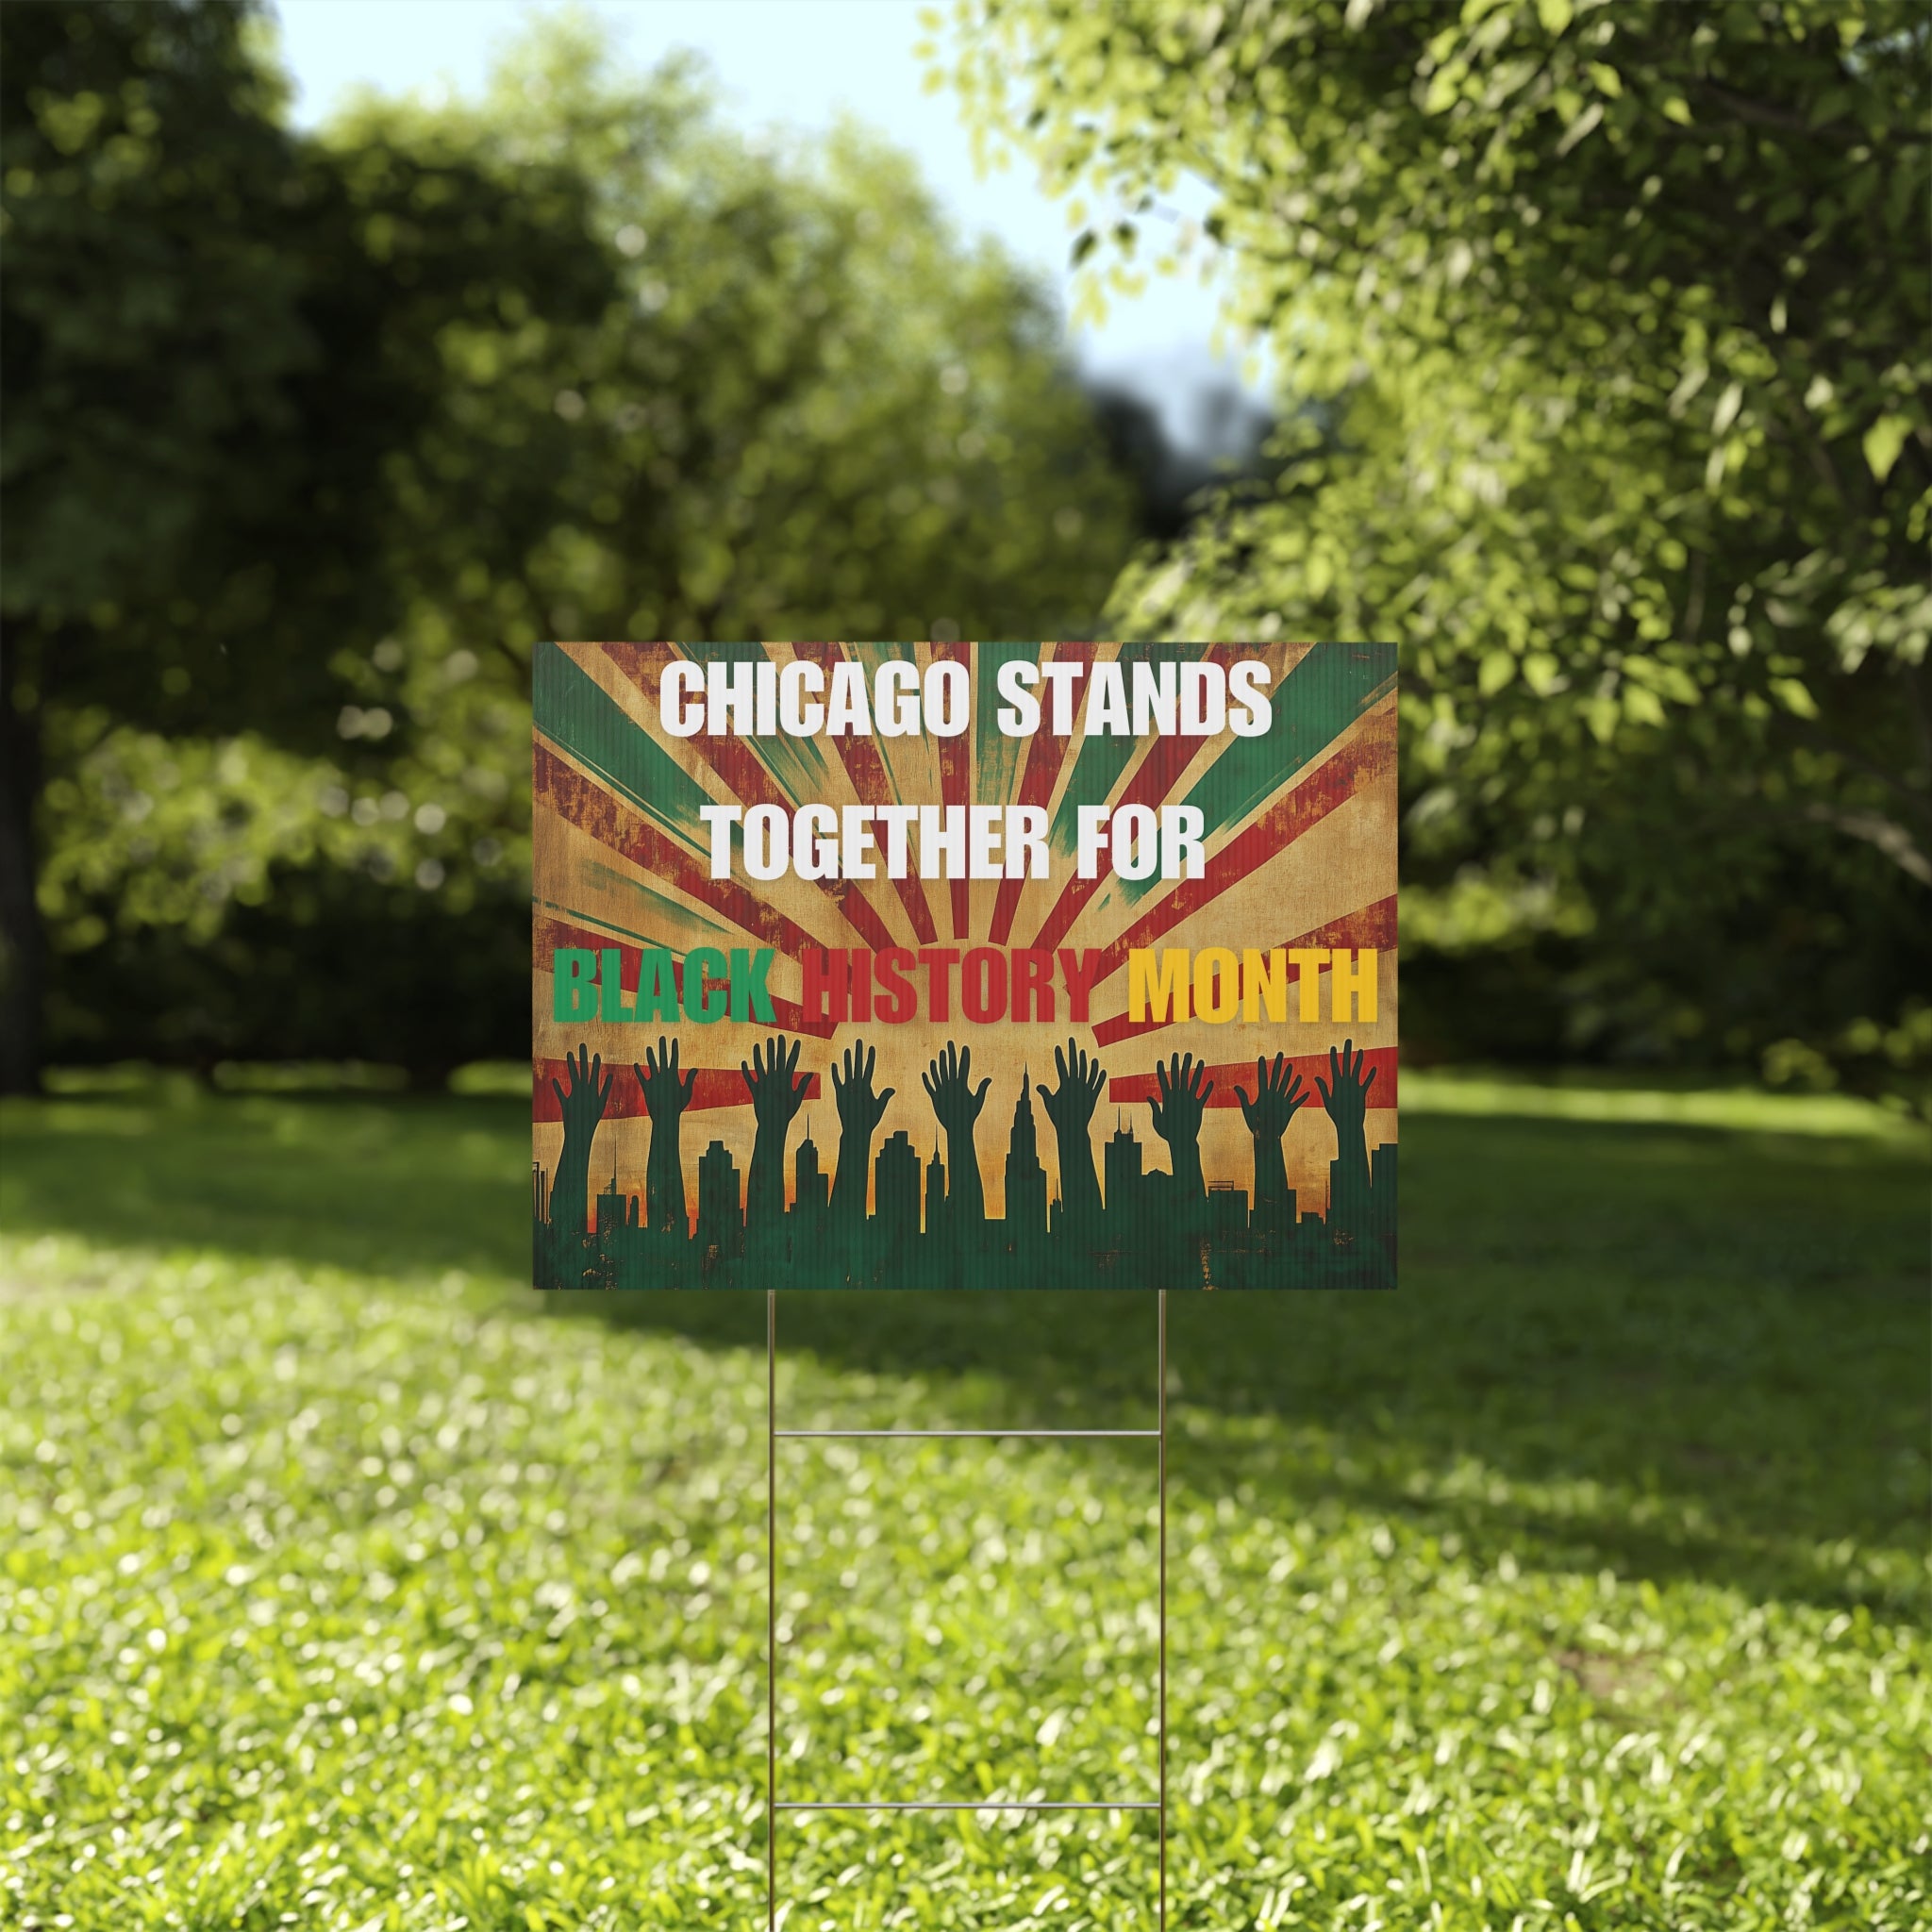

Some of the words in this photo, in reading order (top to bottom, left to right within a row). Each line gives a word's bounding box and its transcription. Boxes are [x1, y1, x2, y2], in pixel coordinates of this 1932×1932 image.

[659, 659, 971, 738] CHICAGO
[996, 659, 1273, 738] STANDS
[699, 803, 1050, 881] TOGETHER
[1077, 803, 1205, 881] FOR
[553, 946, 777, 1024] BLACK
[802, 946, 1103, 1024] HISTORY
[1128, 946, 1378, 1024] MONTH
